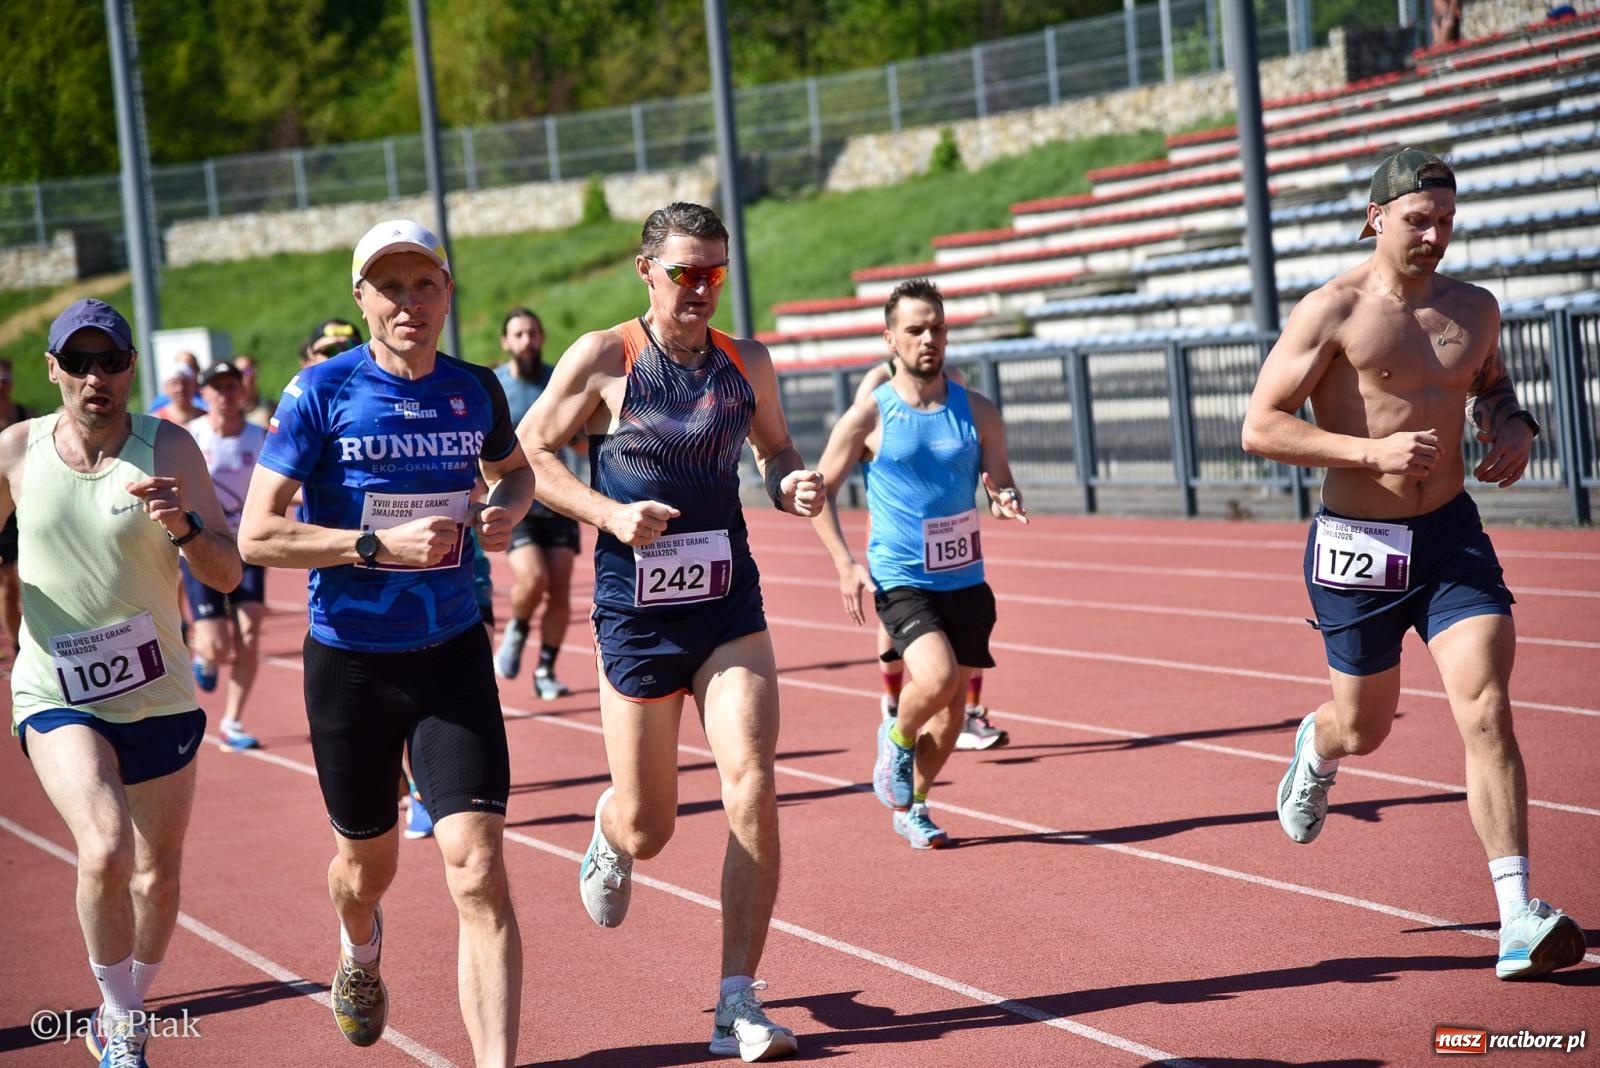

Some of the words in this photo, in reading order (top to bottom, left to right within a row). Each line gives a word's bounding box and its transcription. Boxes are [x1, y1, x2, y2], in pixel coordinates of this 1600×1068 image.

[339, 431, 484, 461] RUNNERS
[441, 462, 468, 471] TEAM
[371, 508, 413, 517] 3MAJA2026
[372, 499, 391, 508] XVIII
[392, 499, 409, 509] BIEG
[410, 500, 423, 509] BEZ
[425, 499, 450, 508] GRANIC
[1364, 526, 1390, 537] GRANIC
[656, 541, 672, 549] BIEG
[673, 539, 685, 547] BEZ
[686, 537, 710, 546] GRANIC
[936, 537, 968, 562] 158
[641, 548, 678, 559] 3MAJA2026
[1330, 549, 1373, 579] 172
[649, 564, 705, 594] 242
[56, 639, 73, 650] XVIII
[73, 636, 90, 647] BIEG
[90, 634, 105, 643] BEZ
[105, 625, 132, 640] GRANIC
[74, 655, 134, 692] 102
